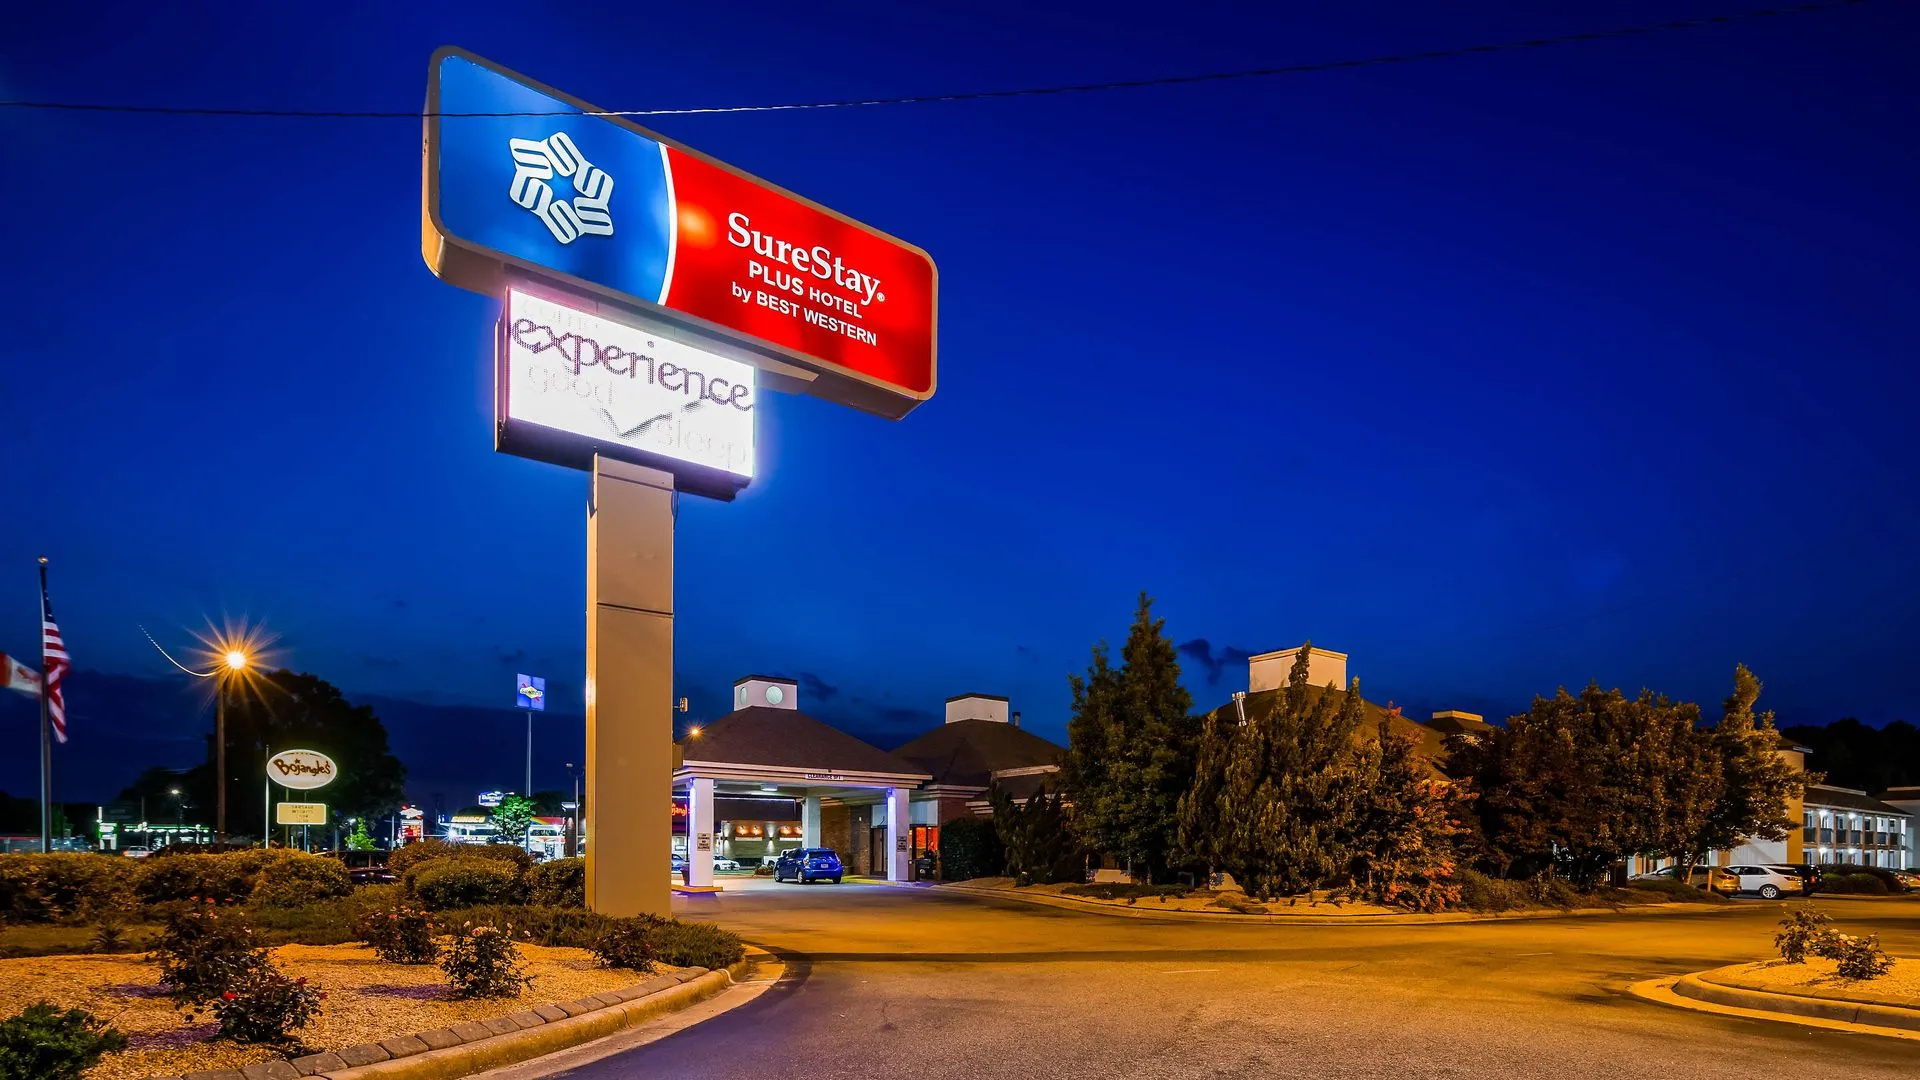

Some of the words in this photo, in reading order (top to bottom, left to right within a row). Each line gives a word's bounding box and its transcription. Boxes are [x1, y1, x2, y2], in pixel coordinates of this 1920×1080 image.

[732, 281, 752, 303] by
[756, 290, 800, 318] BEST
[804, 307, 877, 346] WESTERN
[749, 260, 804, 296] PLUS
[809, 286, 862, 318] HOTEL
[512, 318, 754, 412] experience
